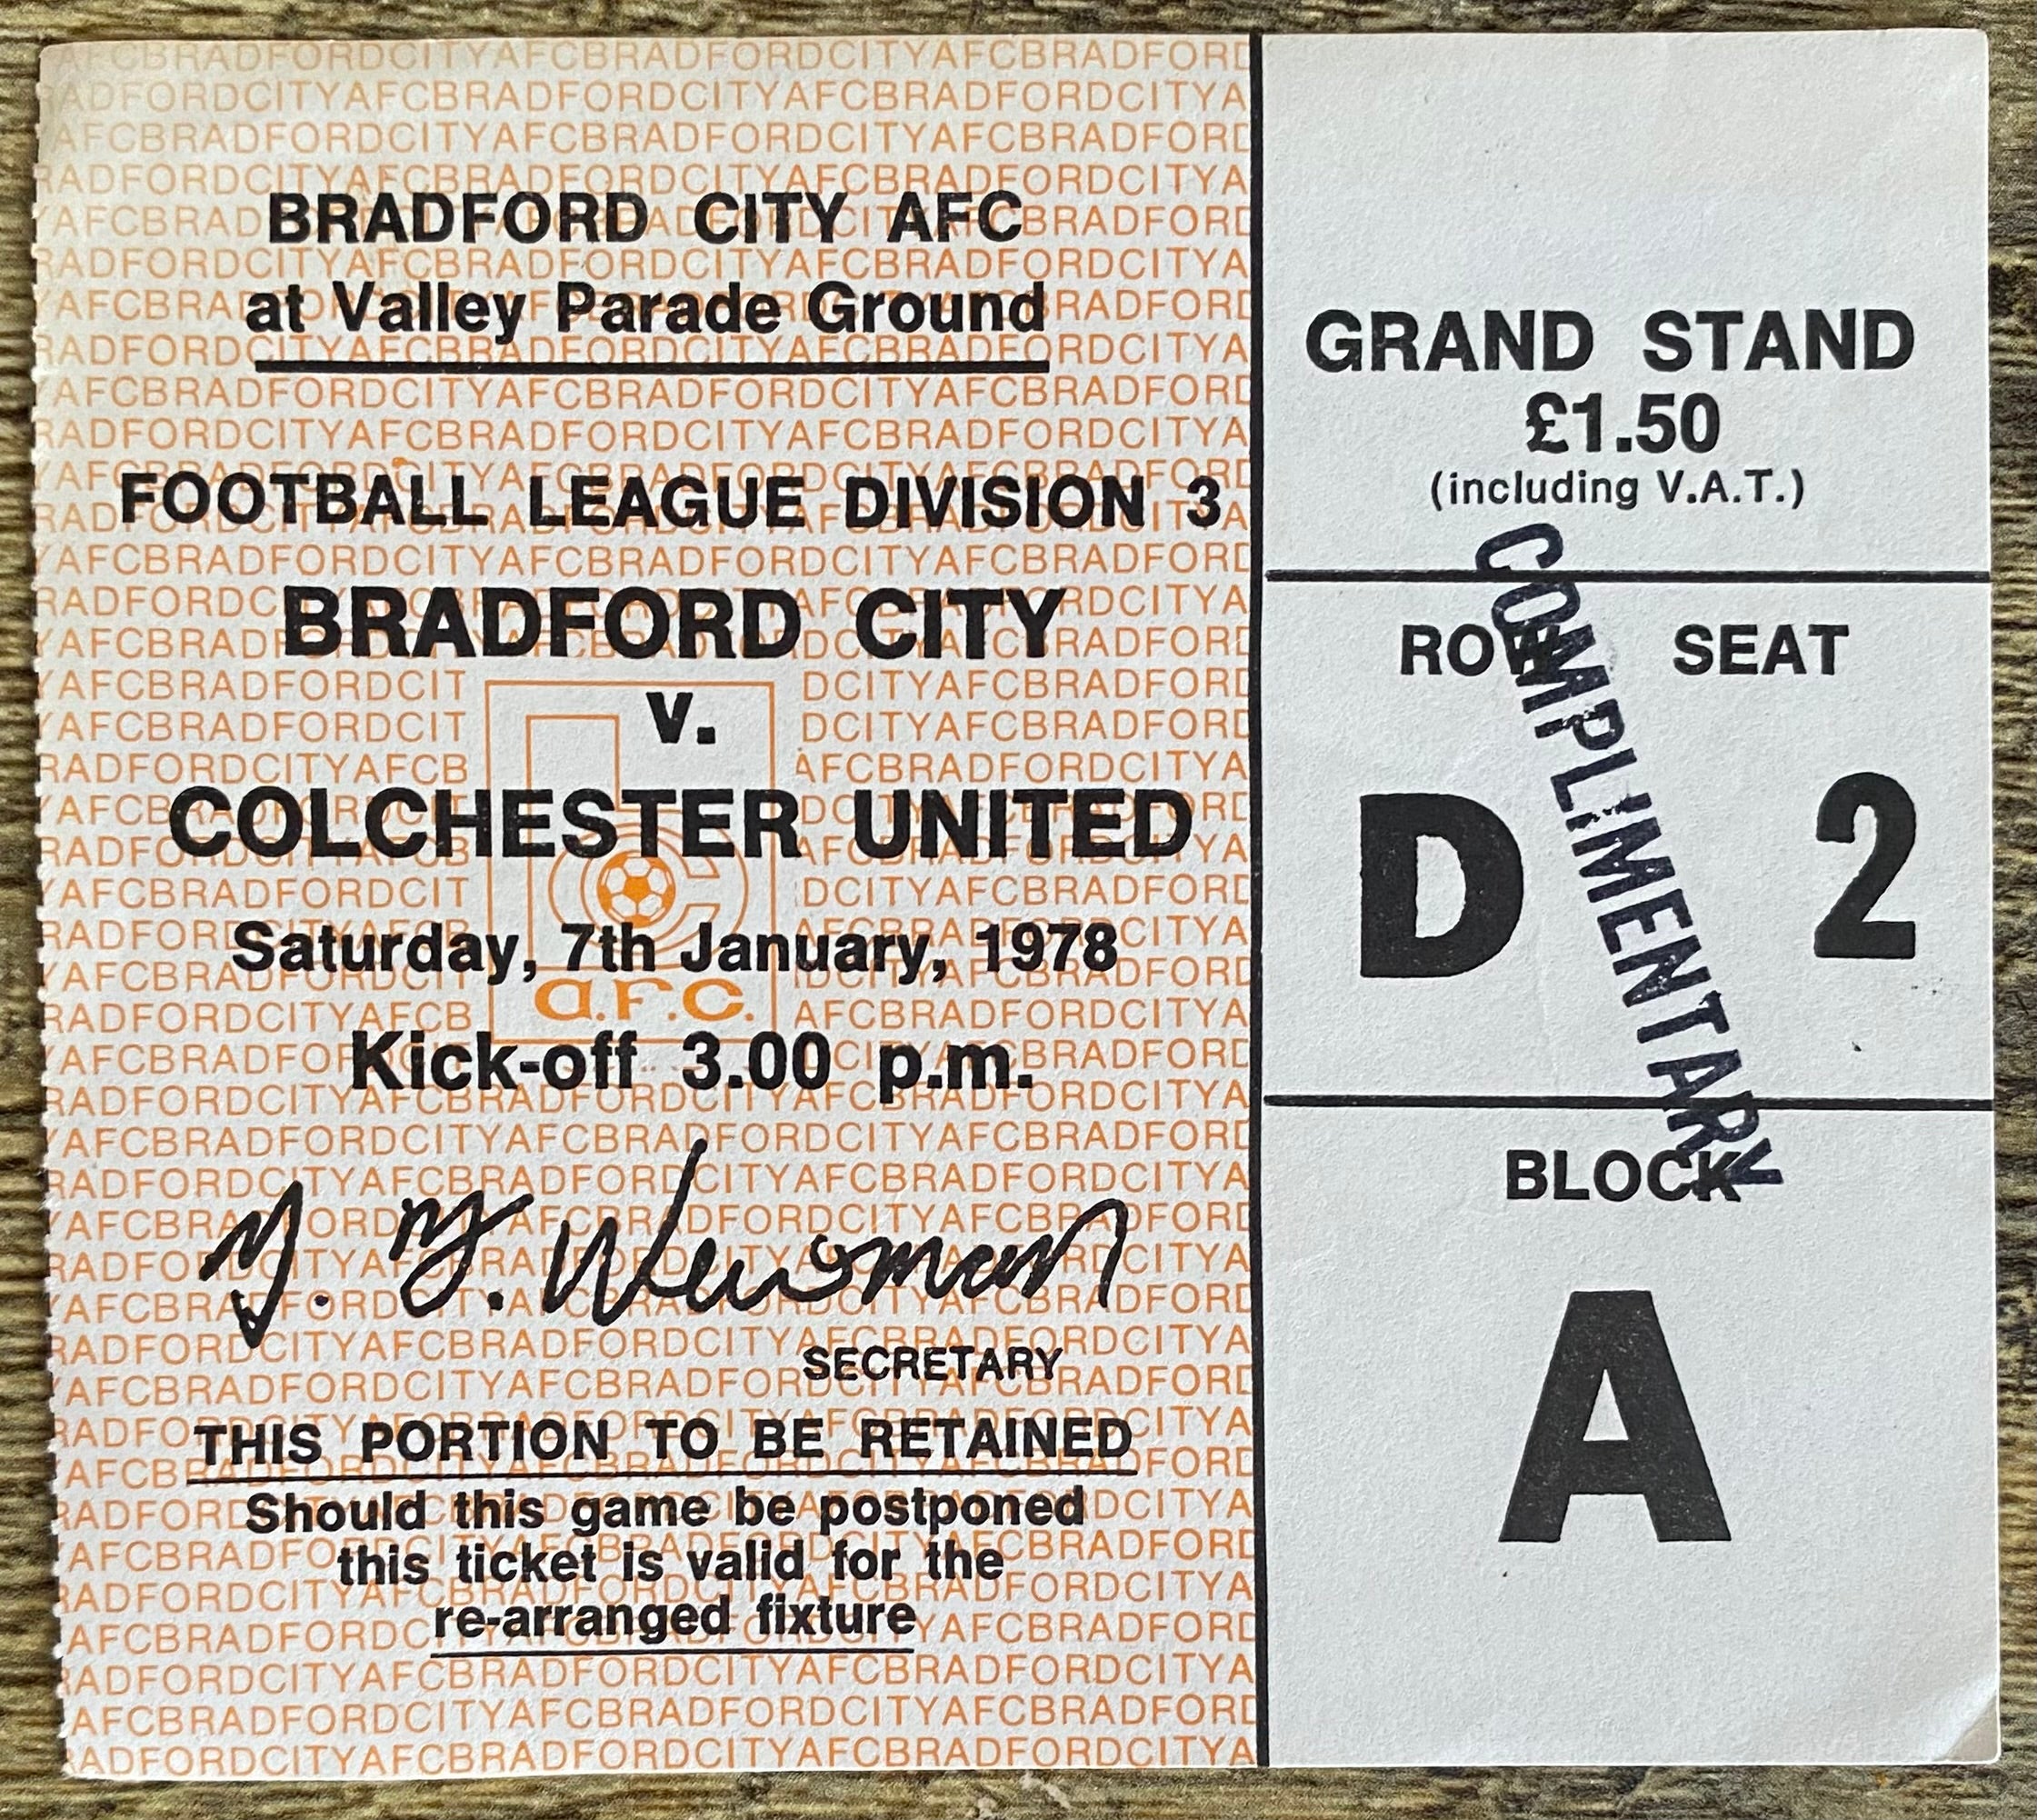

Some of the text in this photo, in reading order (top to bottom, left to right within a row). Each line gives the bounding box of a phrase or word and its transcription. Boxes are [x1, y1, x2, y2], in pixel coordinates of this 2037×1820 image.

[270, 190, 1022, 244] BRADFORD CITY AFC
[246, 281, 1044, 345] at Valley Parade Ground
[1306, 309, 1914, 372] GRAND STAND
[1526, 392, 1720, 454] £1.50
[122, 471, 1220, 528] FOOTBALL LEAGUE DIVISION 3
[1432, 469, 1803, 511] (including V.A.T.)
[284, 585, 1066, 659] BRADFORD CITY
[1674, 625, 1849, 675] SEAT
[646, 692, 715, 744] v.
[169, 786, 1192, 859] COLCHESTER UNITED
[1360, 772, 1916, 978] D 2
[1475, 523, 1784, 1198] COMPLIMENTARY
[233, 921, 1117, 985] Saturday, 7th January, 1978
[352, 1030, 1033, 1104] Kick-off 3.00 p.m.
[1507, 1150, 1741, 1202] BLOCK
[804, 1345, 1063, 1381] SECRETARY
[194, 1417, 1132, 1465] THIS PORTION TO BE RETAINED
[1499, 1290, 1732, 1543] A
[246, 1485, 1083, 1537] Should this game be postponed
[337, 1539, 1004, 1585] this ticket is valid for the
[435, 1593, 916, 1645] re-arranged fixture
